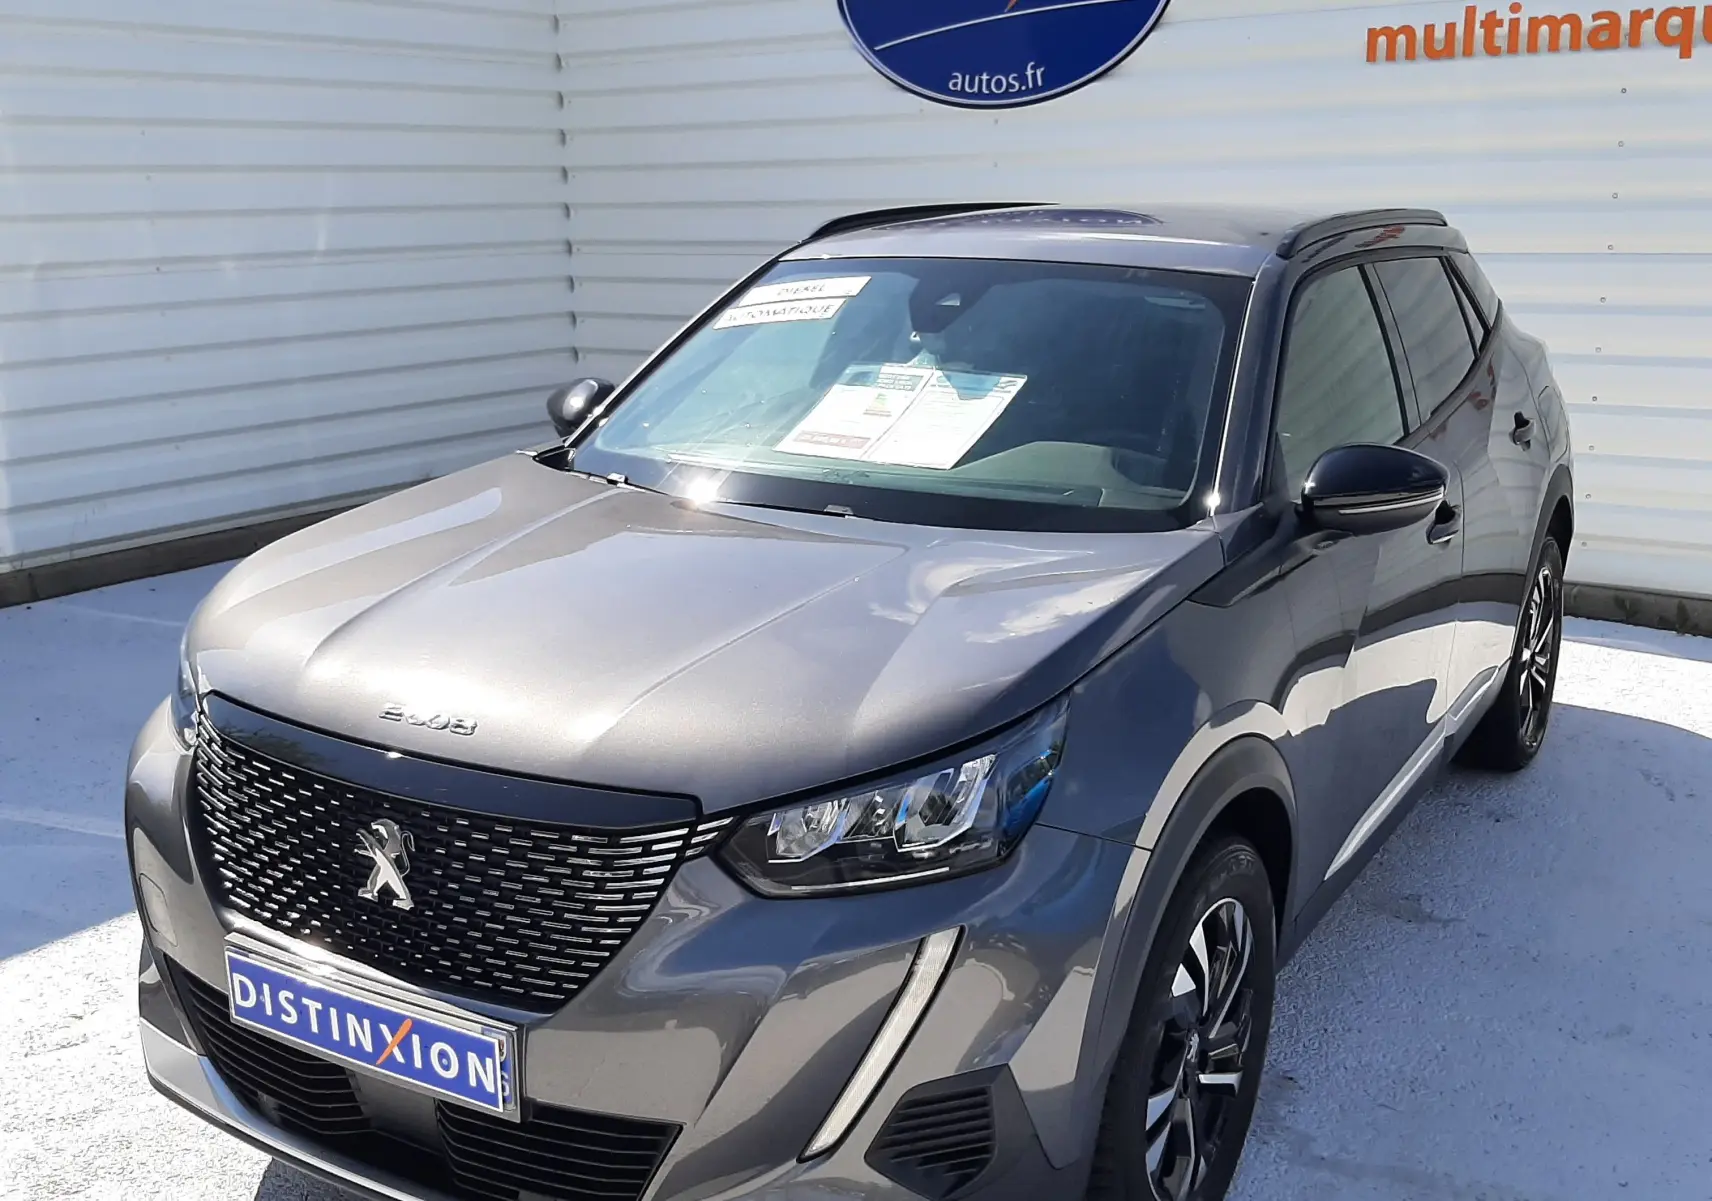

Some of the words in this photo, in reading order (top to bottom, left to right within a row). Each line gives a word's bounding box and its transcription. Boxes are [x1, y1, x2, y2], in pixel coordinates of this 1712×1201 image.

[948, 62, 1046, 94] autos.fr
[379, 702, 478, 736] 2008
[232, 972, 496, 1094] DISTINXION
